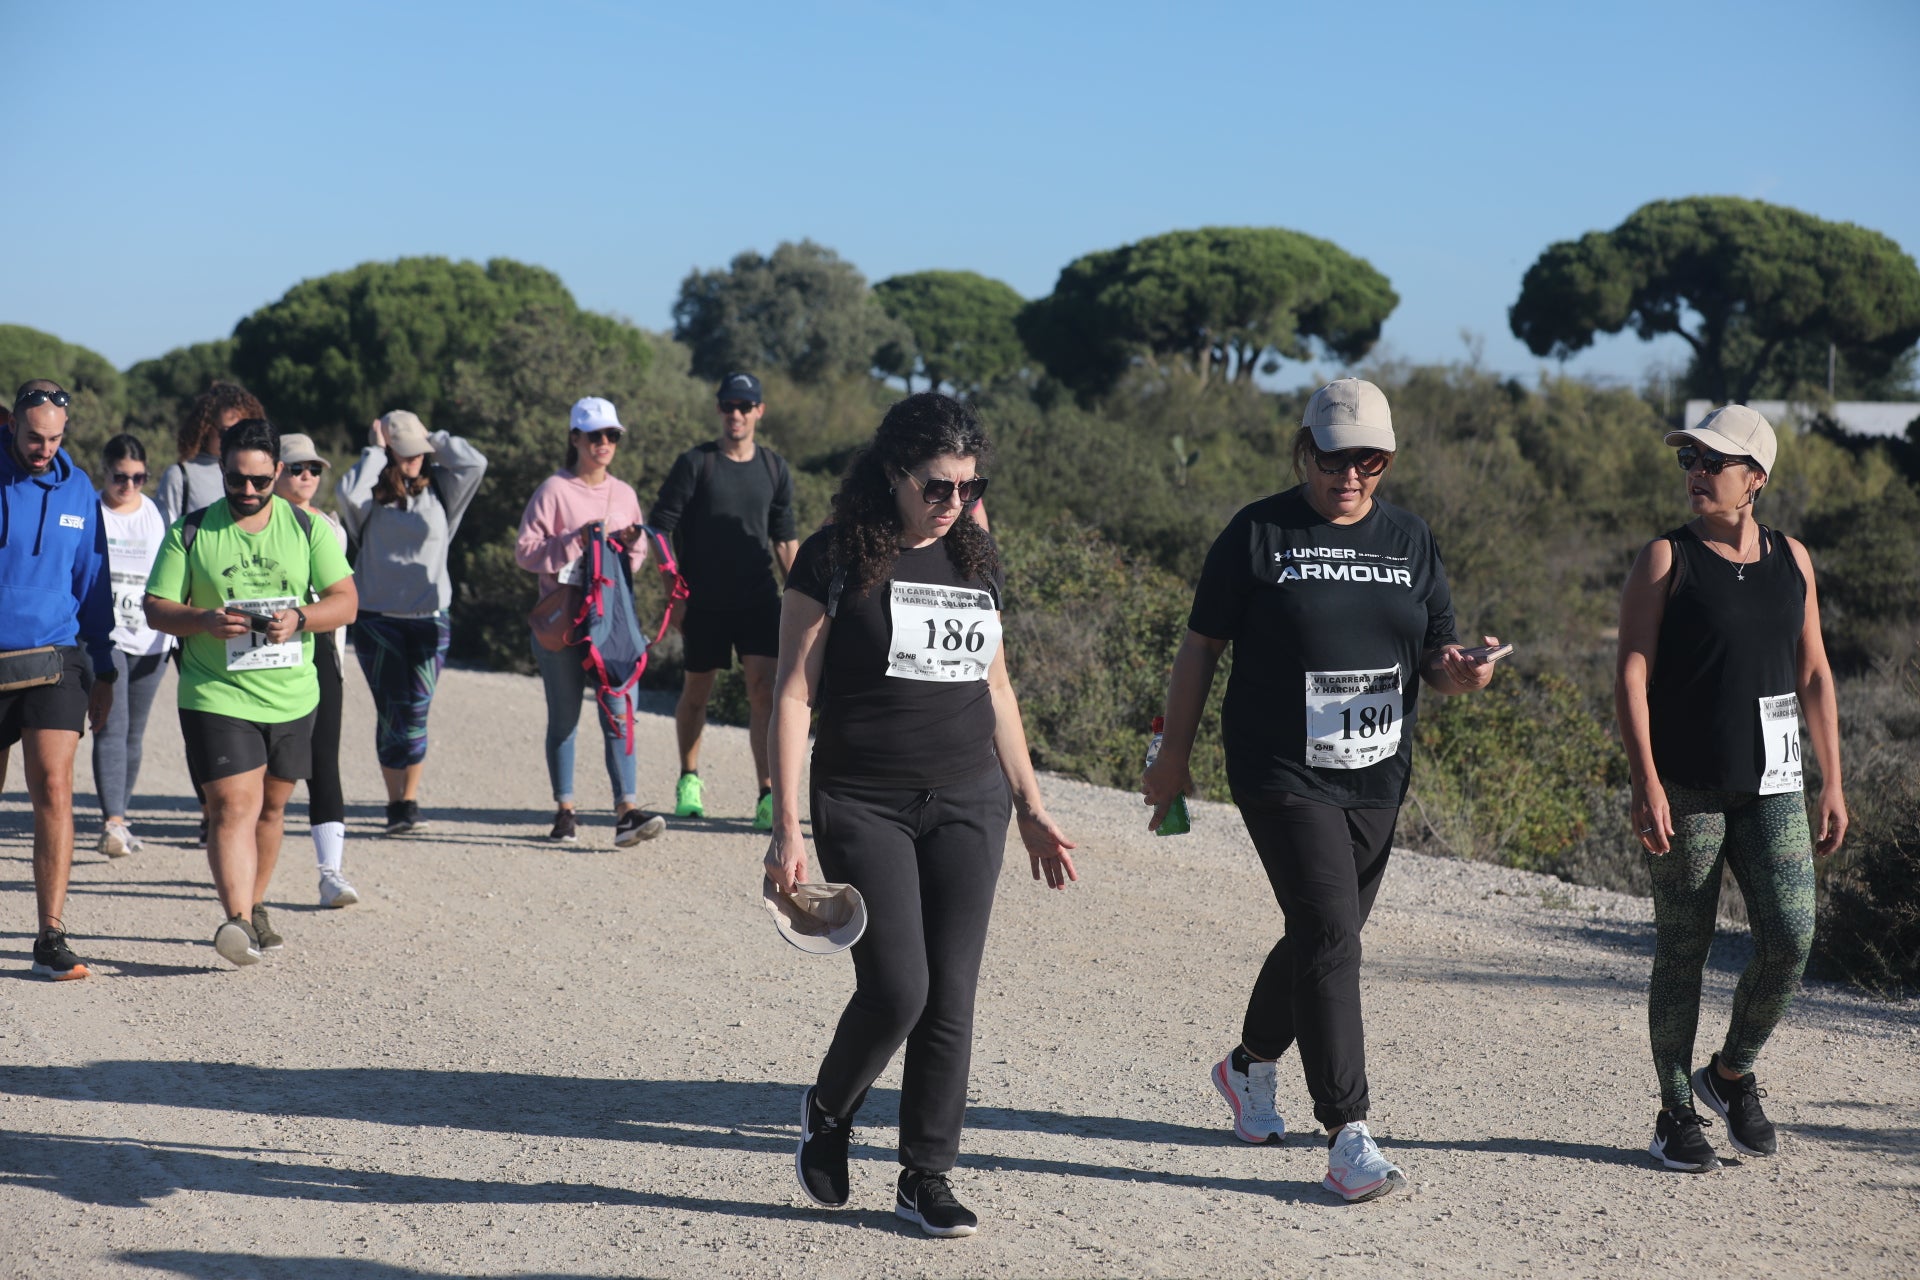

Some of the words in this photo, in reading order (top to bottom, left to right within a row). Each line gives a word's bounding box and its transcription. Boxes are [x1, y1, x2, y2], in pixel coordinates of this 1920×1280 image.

[1292, 547, 1357, 559] UNDER
[1277, 563, 1413, 588] ARMOUR
[907, 588, 948, 598] CARRERA
[902, 597, 939, 606] MARCHA
[941, 600, 980, 608] SOLIDAR
[922, 618, 985, 653] 186
[1314, 676, 1327, 684] VII
[1328, 675, 1371, 684] CARRERA
[1314, 686, 1320, 694] Y
[1322, 685, 1361, 694] MARCHA
[1363, 683, 1398, 692] SOLIDAR
[1772, 710, 1790, 719] MARCH
[1338, 703, 1393, 741] 180
